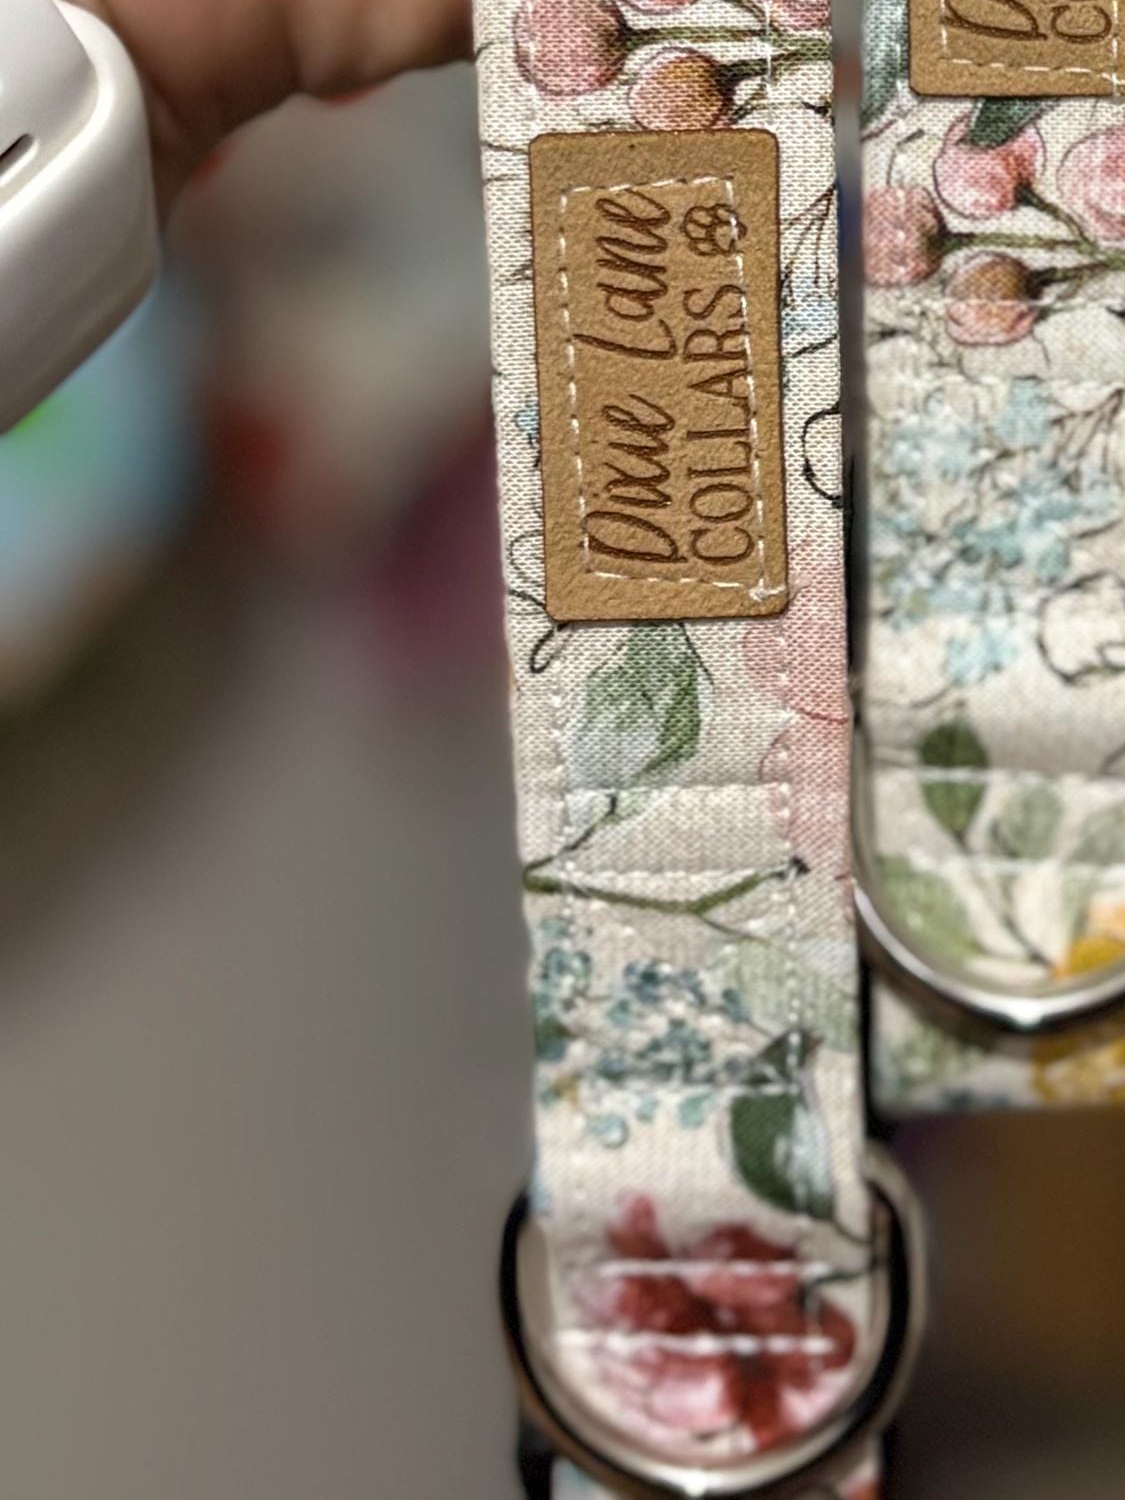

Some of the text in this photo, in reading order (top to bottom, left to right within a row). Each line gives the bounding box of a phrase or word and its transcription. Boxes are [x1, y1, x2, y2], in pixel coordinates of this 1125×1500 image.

[572, 189, 687, 564] Dixie Lane
[683, 284, 756, 566] COLLARS
